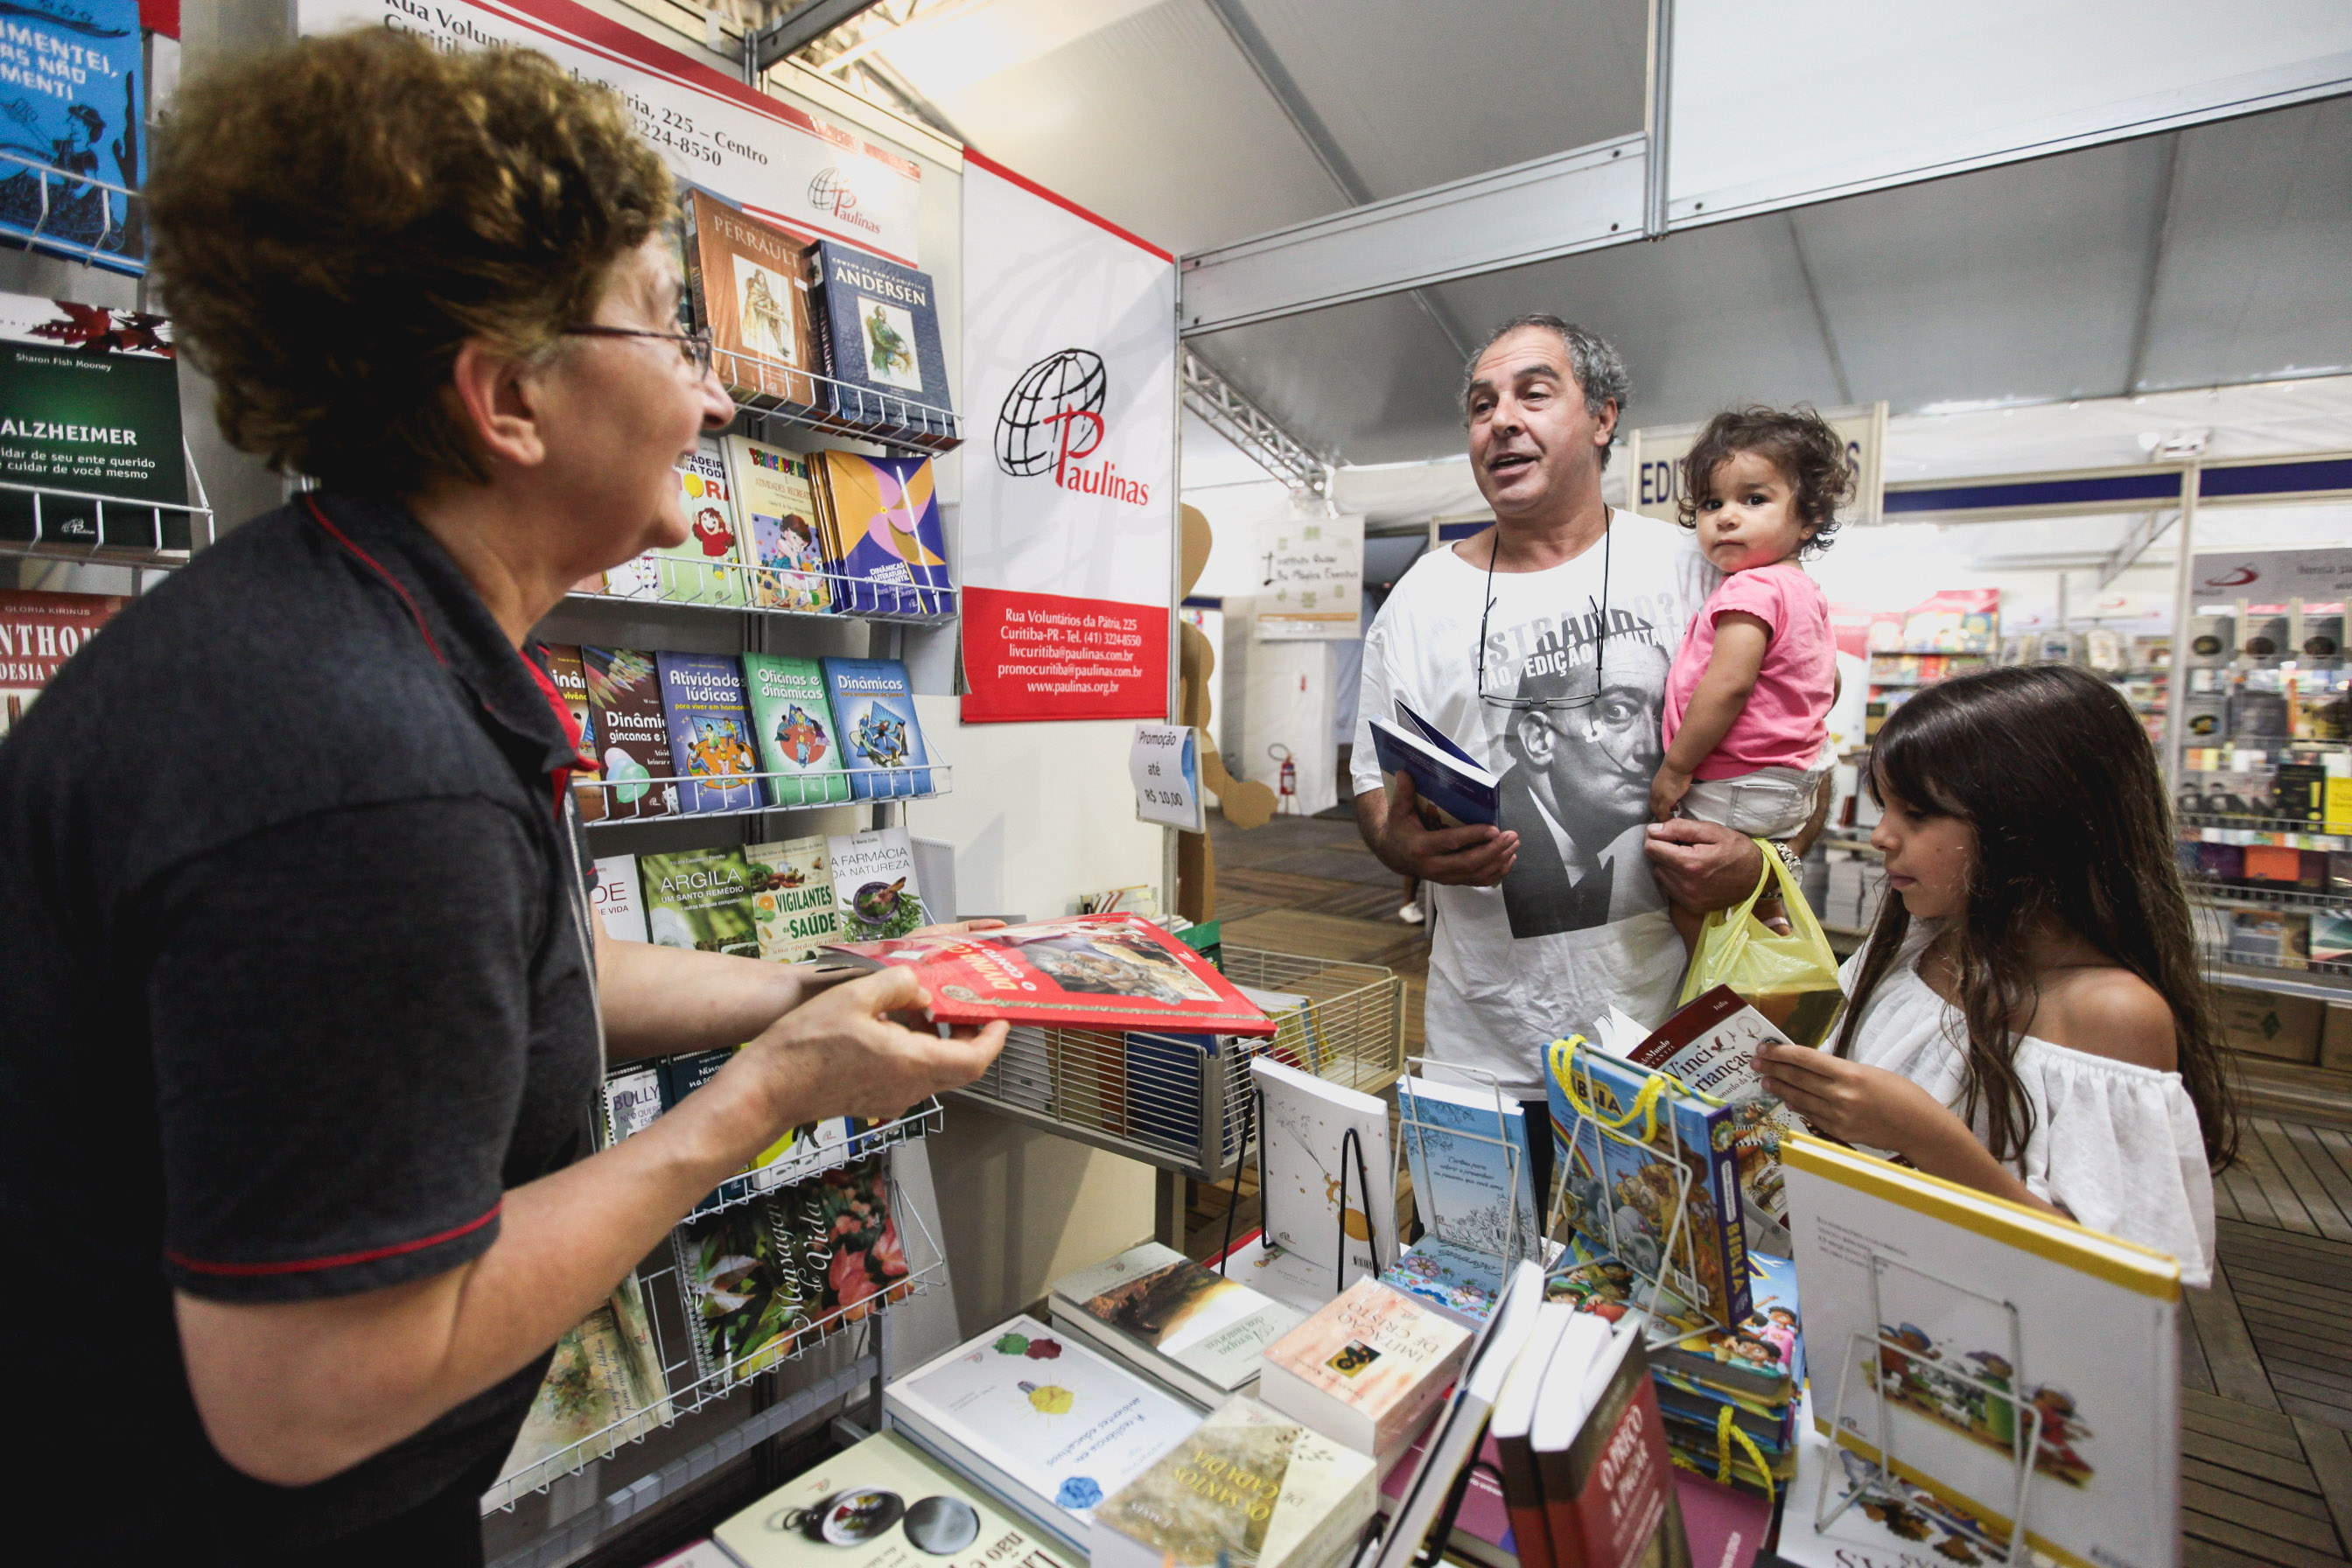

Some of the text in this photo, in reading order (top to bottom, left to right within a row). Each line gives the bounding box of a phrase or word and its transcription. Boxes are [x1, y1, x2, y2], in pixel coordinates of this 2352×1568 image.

[0, 19, 118, 78] MENTEI,
[39, 56, 86, 85] NÃO
[662, 108, 696, 135] 225
[714, 130, 769, 167] Centro
[830, 186, 881, 234] Paulinas
[714, 214, 800, 269] PERRAULT
[836, 266, 927, 307] ANDERSEN
[16, 353, 112, 372] Sharon Fish Mooney
[0, 418, 138, 445] ALZHEIMER
[31, 449, 46, 460] de
[51, 453, 73, 462] seu
[78, 455, 105, 465] ente
[109, 458, 156, 469] querido
[1044, 403, 1150, 506] Paulinas
[7, 461, 148, 479] cuidar de você mesmo
[1005, 608, 1025, 622] Rua
[1028, 610, 1081, 626] Voluntários
[1082, 614, 1096, 627] da
[1123, 619, 1137, 630] 225
[1001, 626, 1059, 641] Curitiba-PR
[1067, 630, 1082, 643] Tel.
[1084, 632, 1102, 644] (41)
[1010, 644, 1133, 662] livcuritiba@paulinas.com.br
[1524, 639, 1592, 677] EDIÇÃO
[758, 668, 820, 686] Oficinas e
[837, 675, 904, 690] Dinâmicas
[998, 663, 1143, 679] promocuritiba@paulinas.com.br
[687, 686, 738, 703] lúdicas
[761, 683, 823, 700] dinâmicas
[1027, 680, 1119, 696] www.paulinas.org.br
[609, 729, 652, 744] gincanas
[654, 733, 662, 742] e
[1138, 732, 1176, 748] Promoção
[1147, 761, 1160, 776] até
[1144, 788, 1183, 806] R$ 10,00
[841, 847, 908, 866] FARMÁCIA
[850, 859, 910, 877] NATUREZA
[661, 868, 742, 893] ARGILA
[661, 886, 744, 904] UM SANTO REMÉDIO
[775, 885, 832, 914] VIGILANTES
[608, 905, 629, 914] VIDA
[790, 913, 837, 939] SAÚDE
[791, 942, 812, 952] opção
[982, 948, 1025, 978] CONTO
[1662, 1045, 1715, 1082] Vinci
[1691, 1050, 1754, 1093] rianças
[613, 1084, 660, 1111] BULLY
[797, 1201, 833, 1292] de Vida
[1348, 1302, 1410, 1339] CRISTO
[1046, 1397, 1140, 1466] ambientes educativos
[1192, 1450, 1279, 1499] CADA DIA
[1173, 1467, 1271, 1521] OS SANTOS
